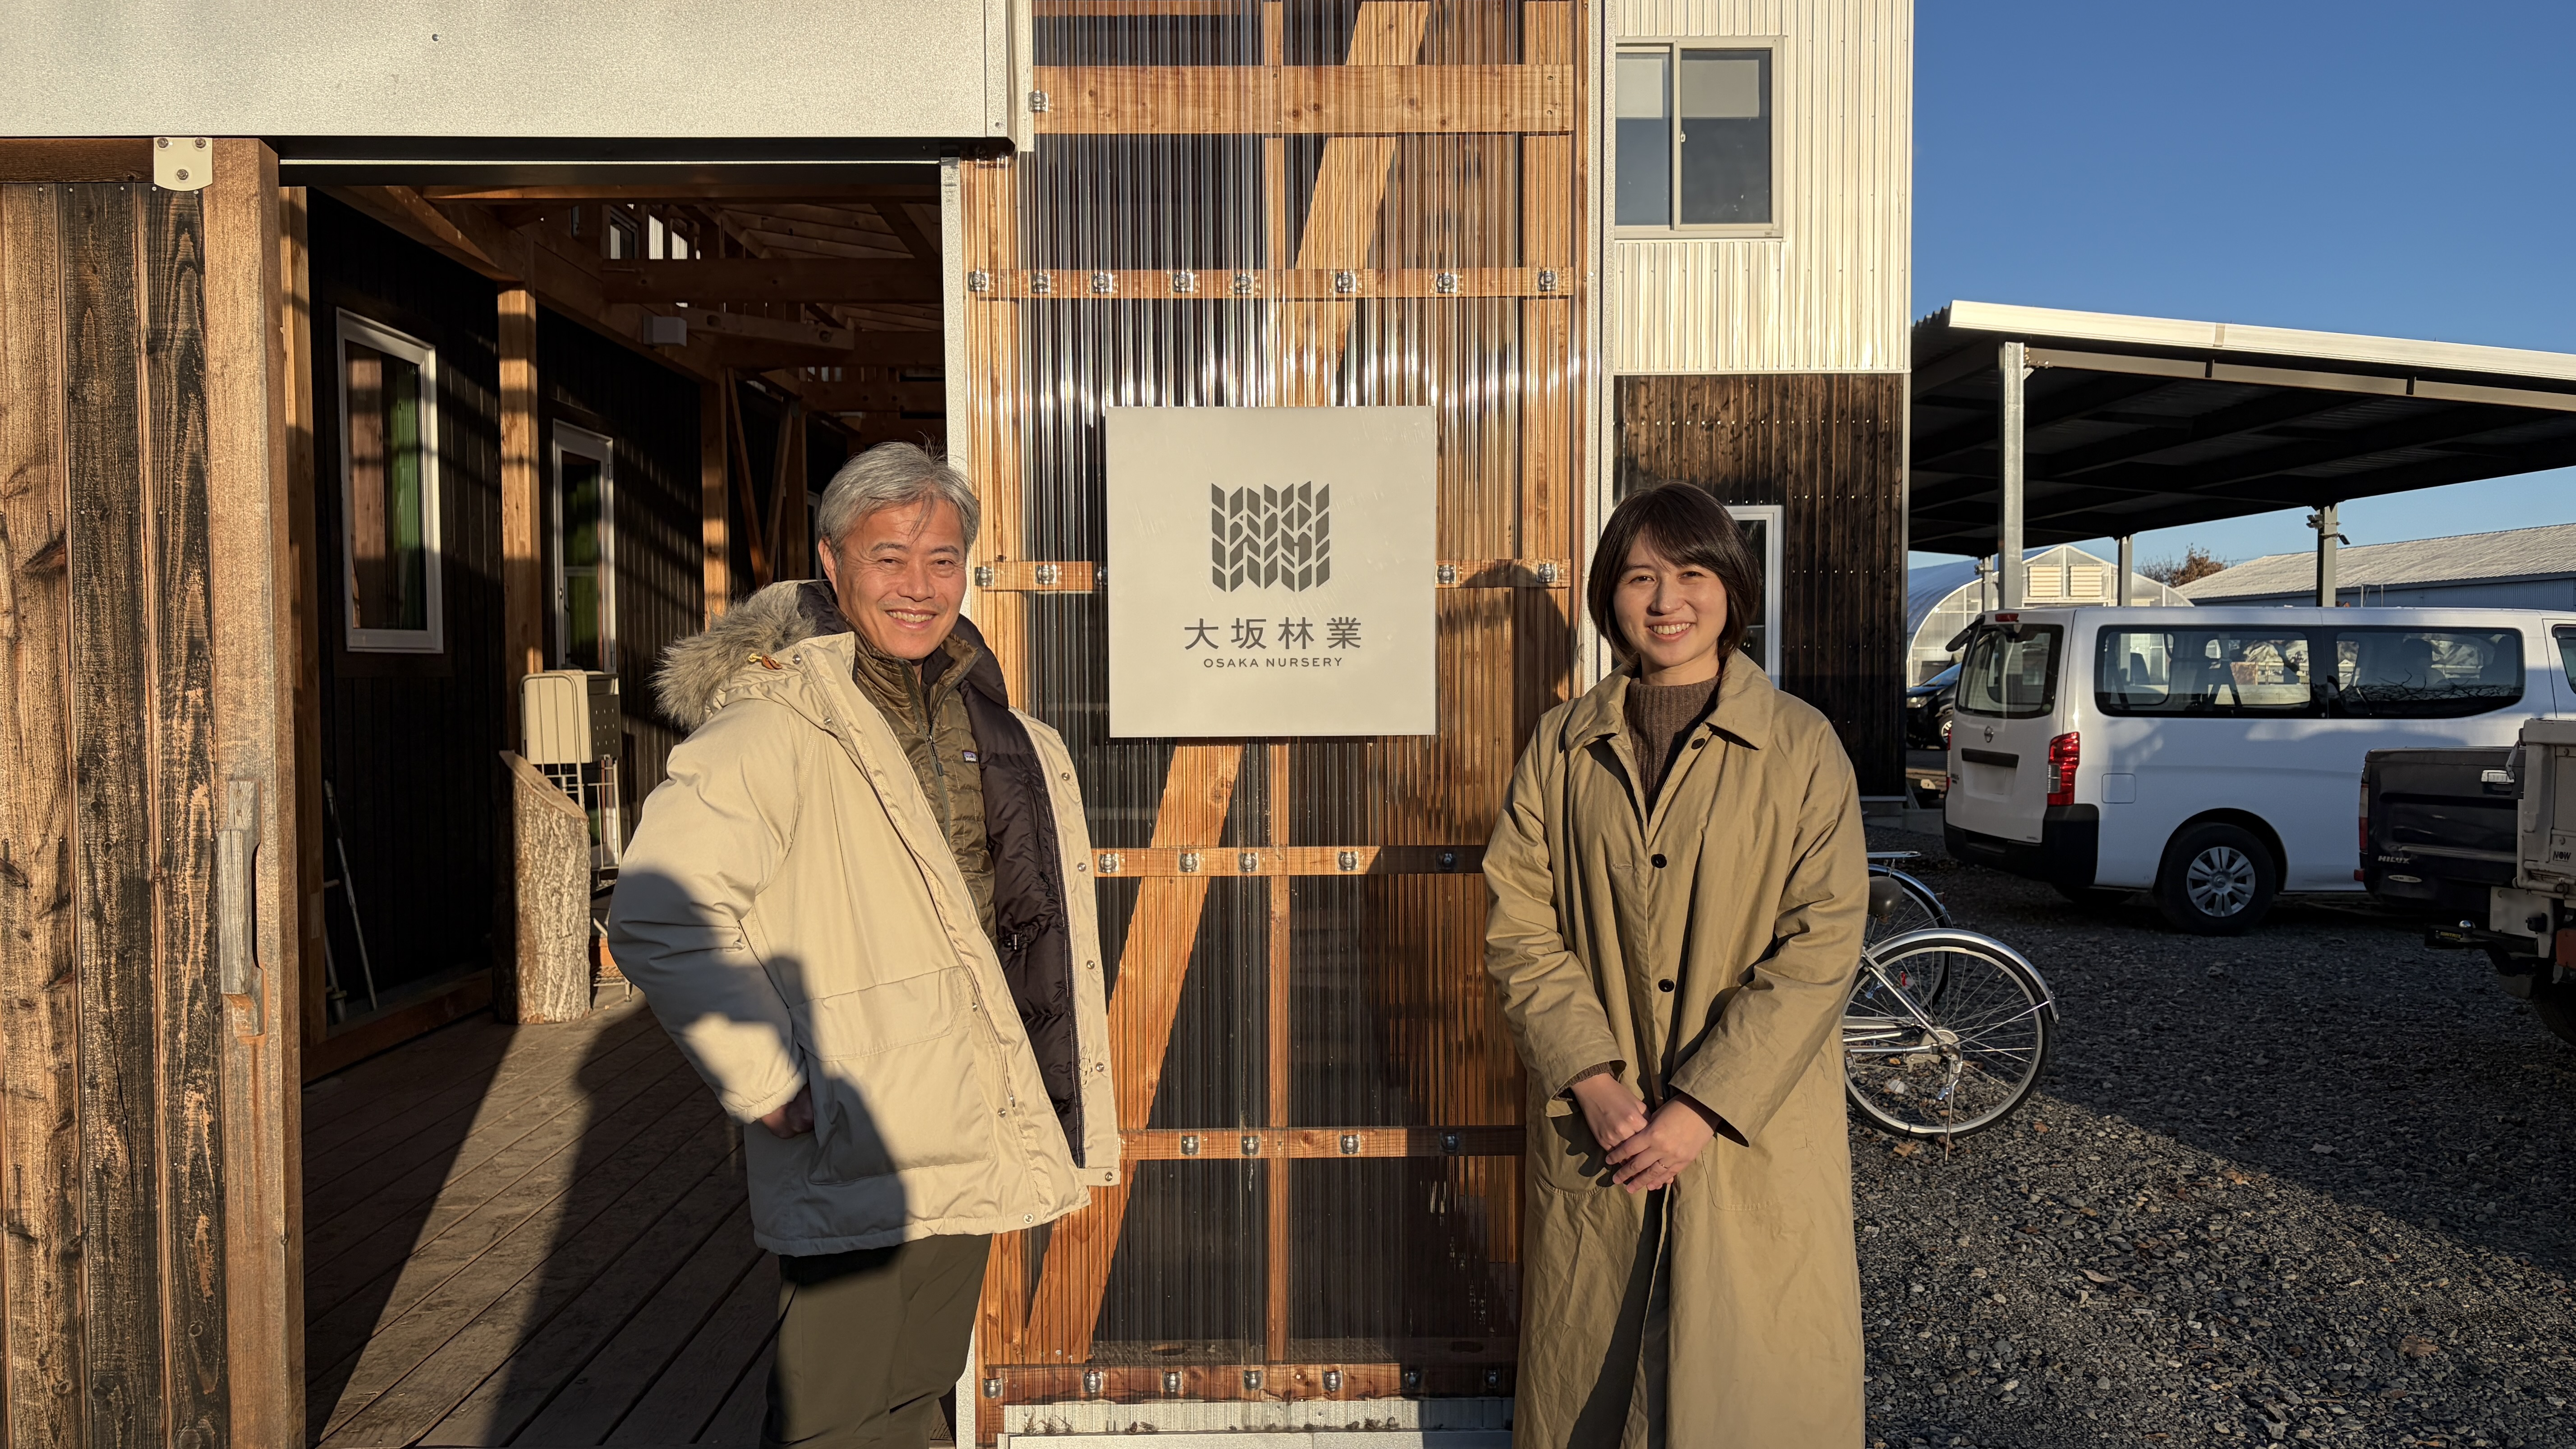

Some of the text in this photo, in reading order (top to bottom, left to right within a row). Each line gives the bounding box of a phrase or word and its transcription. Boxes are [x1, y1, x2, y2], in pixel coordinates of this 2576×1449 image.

[1184, 617, 1361, 650] 大坂林業
[1204, 658, 1342, 668] OSAKA NURSERY
[2378, 855, 2410, 864] HILUX
